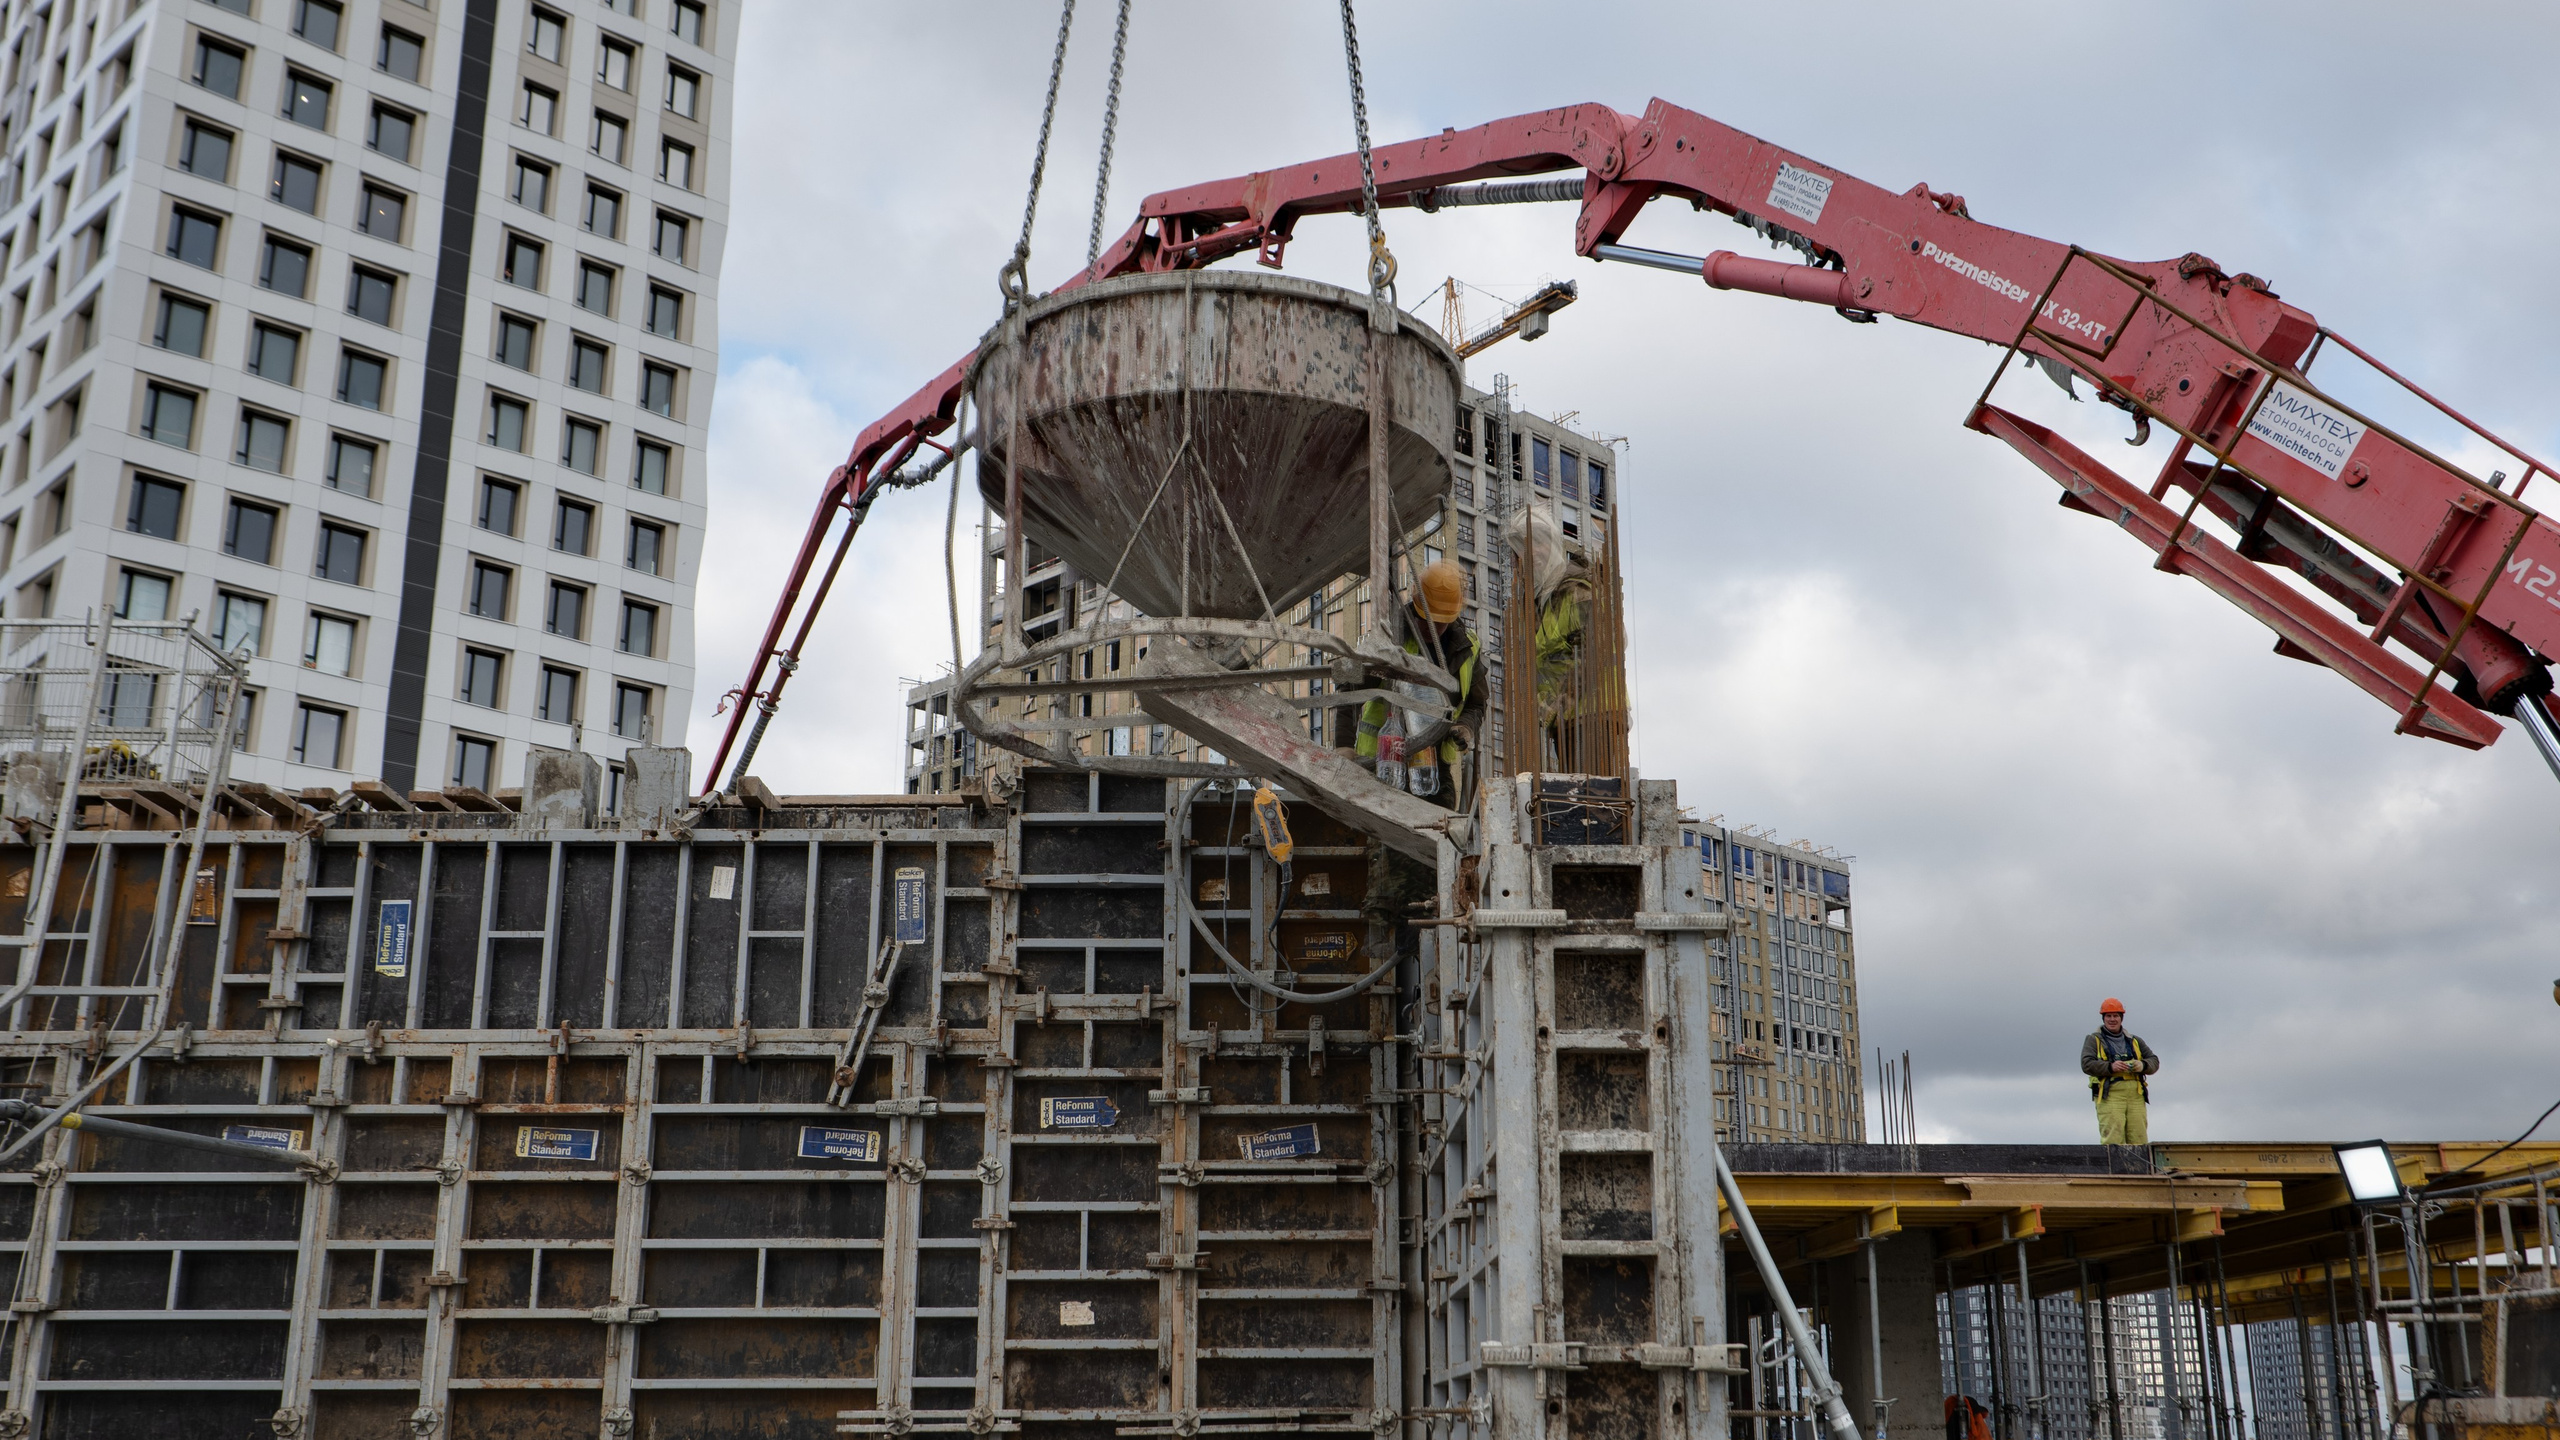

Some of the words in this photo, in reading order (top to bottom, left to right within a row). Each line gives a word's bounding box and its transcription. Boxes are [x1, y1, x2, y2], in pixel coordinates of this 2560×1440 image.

[1777, 180, 1796, 191] АРЕНДА
[1798, 188, 1821, 202] ПРОДАЖА
[1784, 168, 1832, 194] МИХТЕХ
[1922, 241, 2030, 303] Putzmeister
[2058, 308, 2107, 341] 32-4T
[2272, 391, 2358, 445] МИХТЕХ
[2256, 406, 2346, 458] ЕТОНОНАСОСЫ
[899, 882, 908, 920] Standard
[912, 881, 922, 919] ReForma
[380, 925, 393, 963] ReForma
[393, 923, 406, 963] Standard
[1055, 1101, 1095, 1111] ReForma
[1055, 1114, 1096, 1125] Standard
[247, 1129, 289, 1142] Standard
[532, 1130, 572, 1141] ReForma
[824, 1131, 866, 1143] Standard
[530, 1144, 572, 1155] Standard
[824, 1145, 864, 1157] ReForma
[1254, 1144, 1295, 1159] Standard
